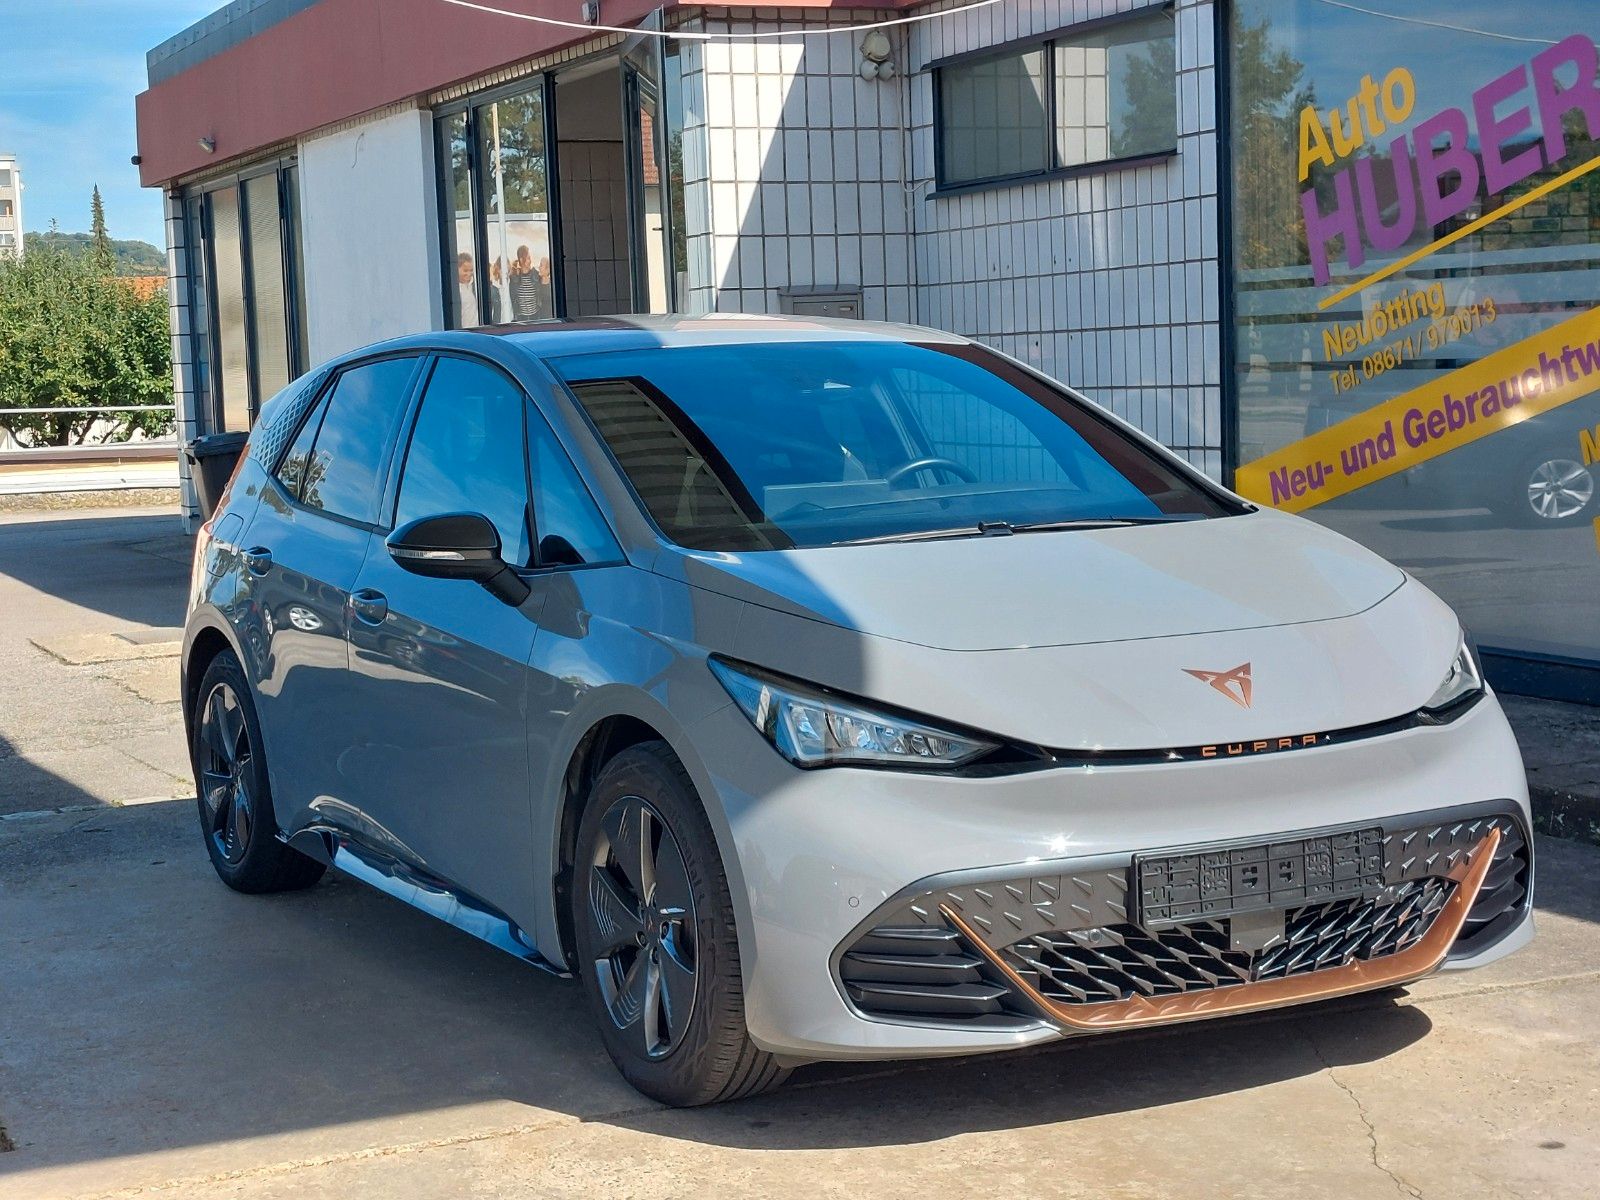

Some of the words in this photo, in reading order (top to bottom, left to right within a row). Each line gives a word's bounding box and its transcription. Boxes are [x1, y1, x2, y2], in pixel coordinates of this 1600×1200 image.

[1298, 67, 1415, 182] Auto
[1302, 33, 1600, 287] HUBER
[1269, 461, 1333, 506] Neu-
[1340, 420, 1396, 476] und
[1403, 338, 1600, 449] Gebrauchtw
[1329, 364, 1361, 395] Tel.
[1202, 735, 1317, 757] CUPRA
